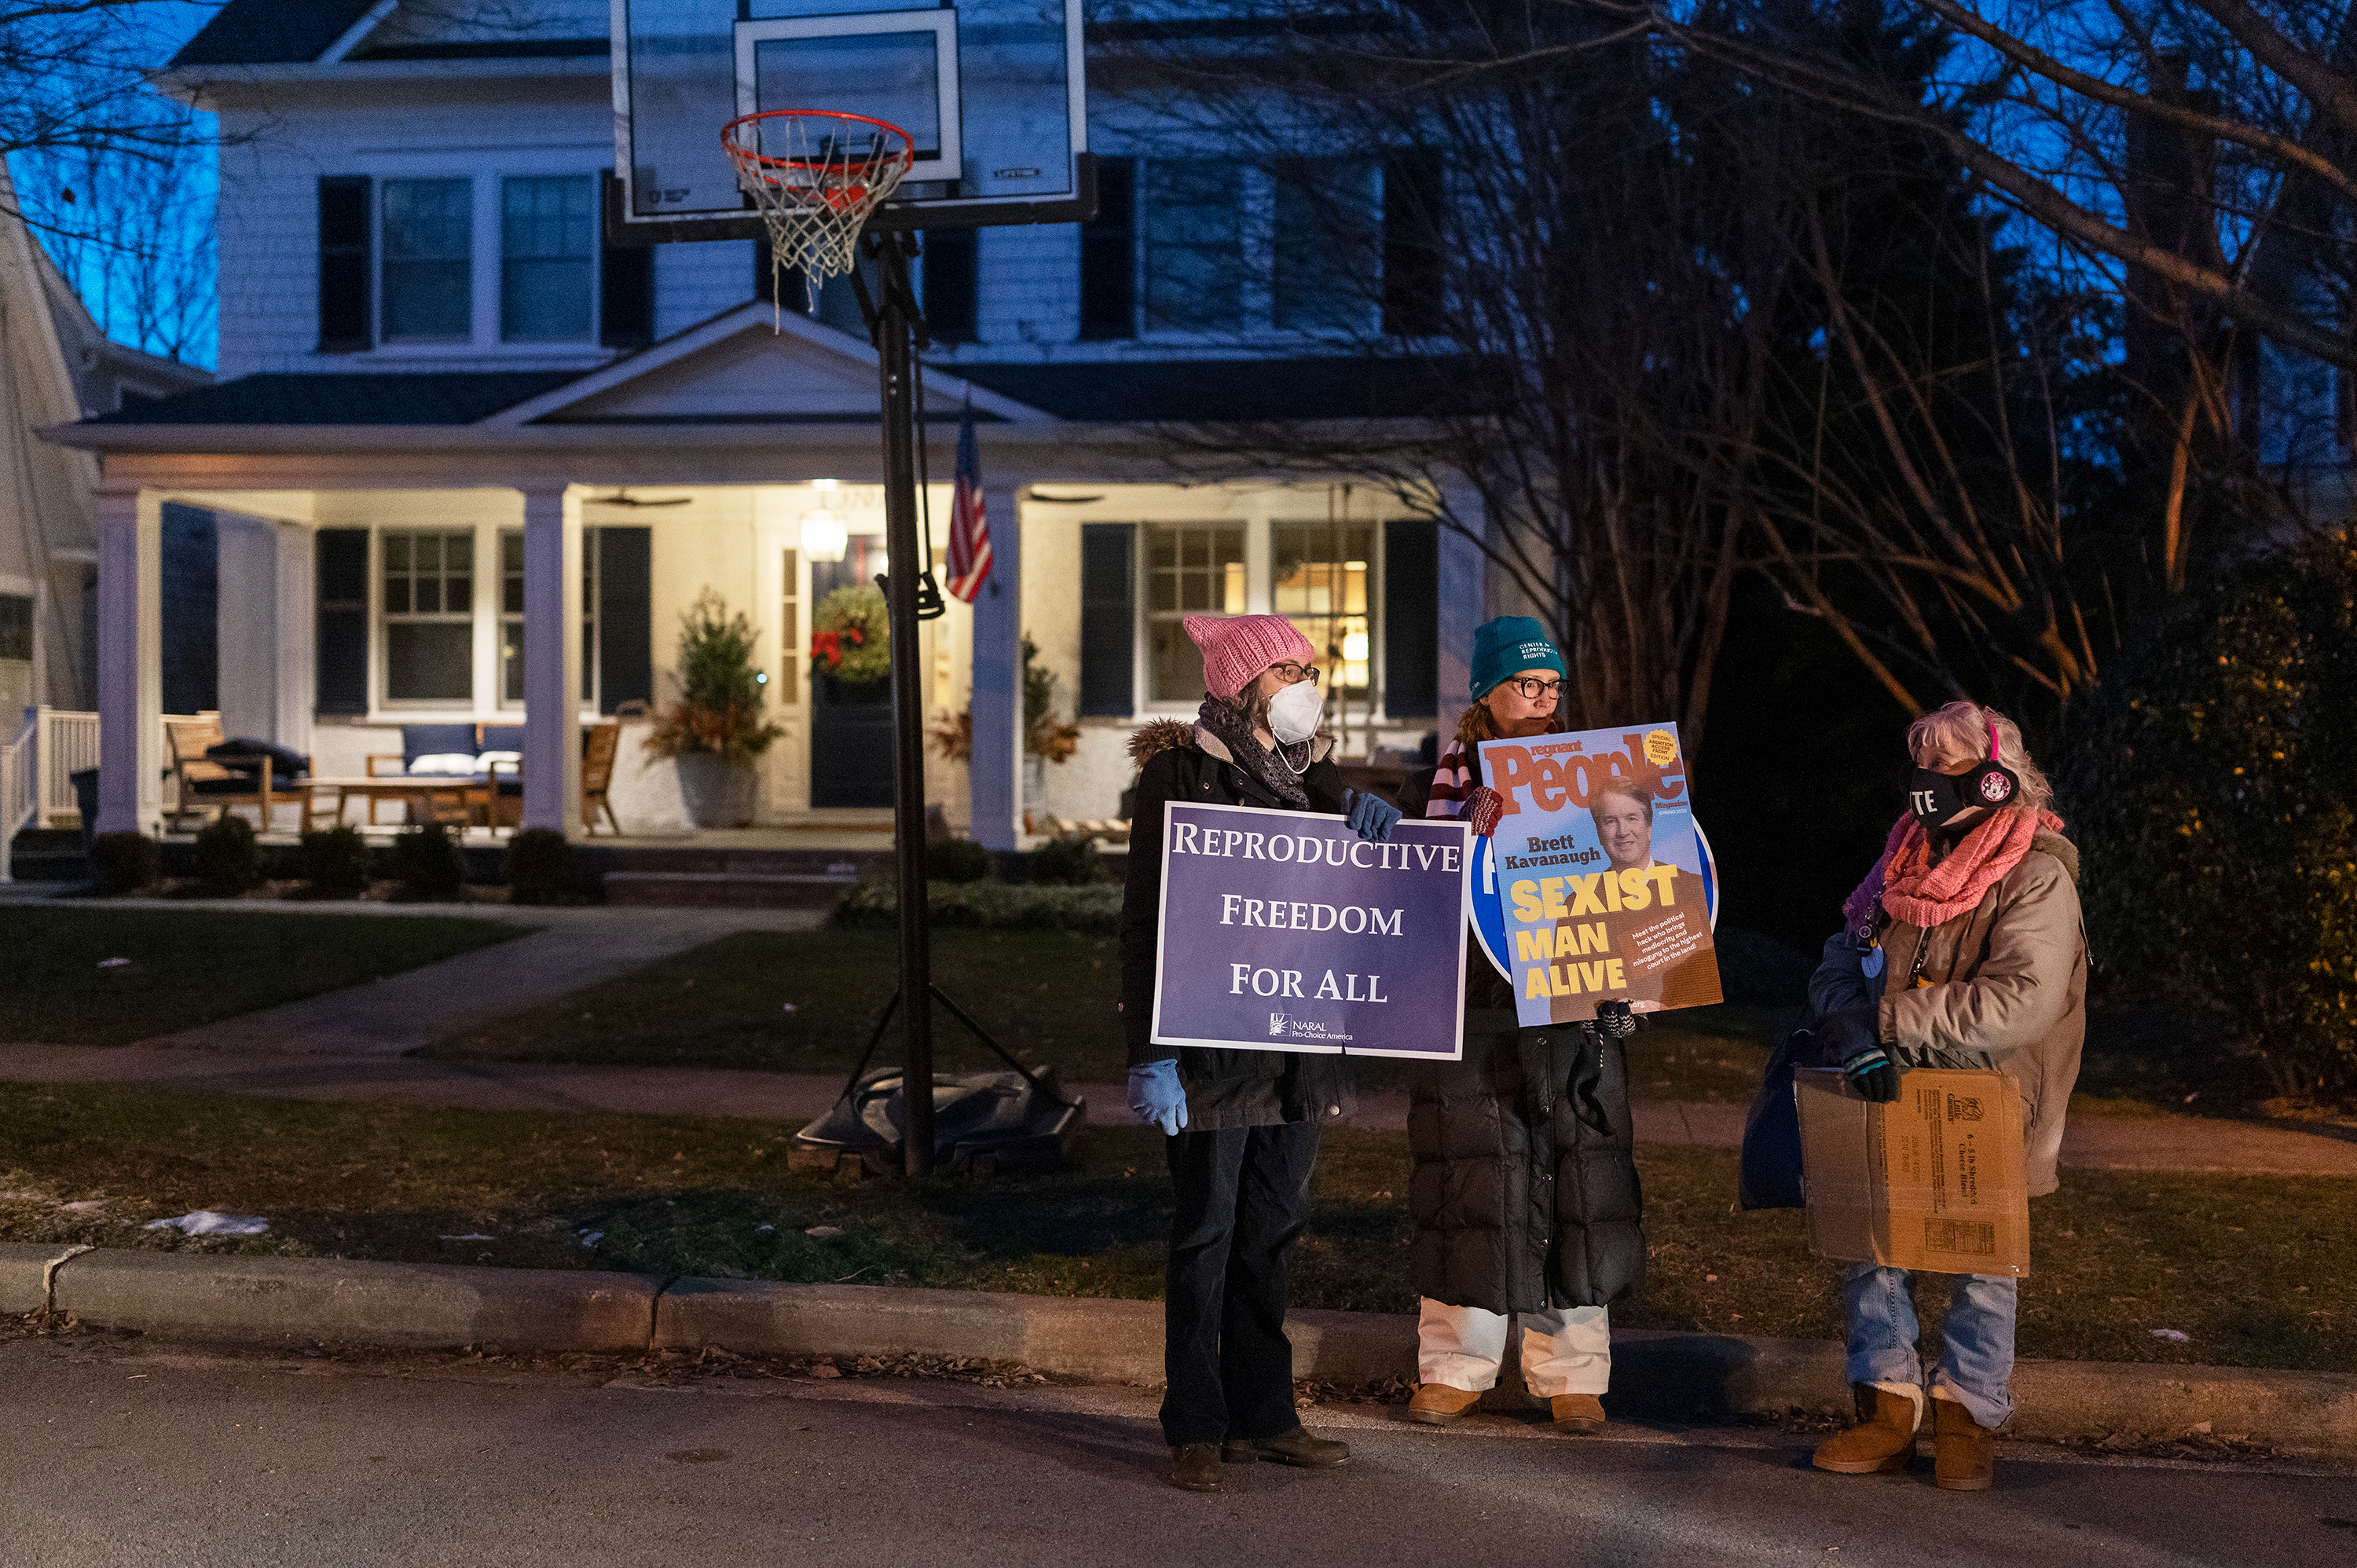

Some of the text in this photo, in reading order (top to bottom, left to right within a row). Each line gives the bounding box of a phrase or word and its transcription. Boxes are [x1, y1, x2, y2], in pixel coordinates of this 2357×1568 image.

[1530, 739, 1583, 758] regnant
[1655, 800, 1688, 809] Magazine
[1171, 822, 1461, 873] REPRODUCTIVE
[1527, 834, 1574, 853] Brett
[1505, 847, 1601, 870] Kavanaugh
[1510, 864, 1678, 923] SEXIST
[1219, 893, 1405, 936] FREEDOM
[1632, 911, 1685, 940] Meet the political
[1516, 921, 1609, 962] MAN
[1637, 921, 1685, 947] hack who brings
[1641, 929, 1688, 954] mediocrity and
[1633, 951, 1662, 967] misogyny
[1669, 942, 1681, 951] the
[1680, 931, 1703, 945] highest
[1647, 958, 1664, 969] court
[1681, 943, 1697, 954] land!
[1229, 963, 1388, 1003] FOR ALL
[1526, 958, 1627, 1000] ALIVE
[1292, 1020, 1327, 1031] NARAL
[1292, 1031, 1353, 1041] Pro-Choice America
[1952, 1099, 1961, 1120] Little
[1958, 1143, 1968, 1172] Cheese
